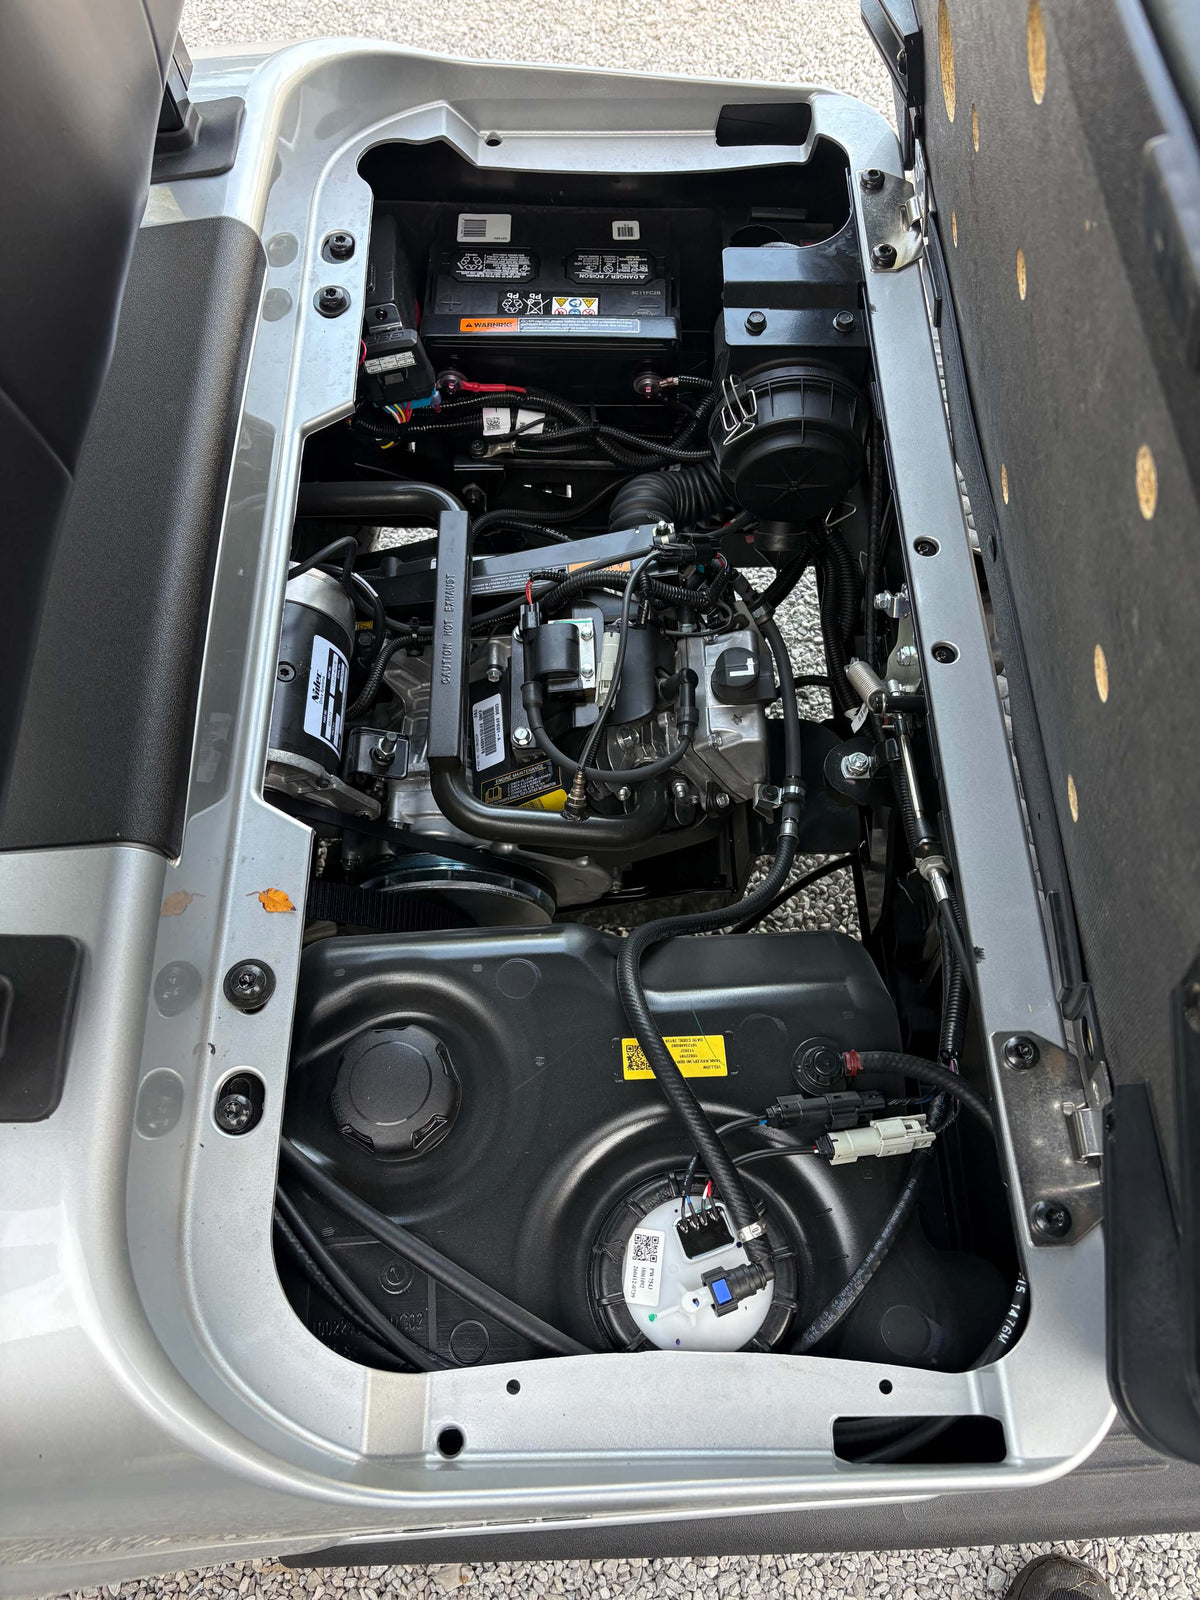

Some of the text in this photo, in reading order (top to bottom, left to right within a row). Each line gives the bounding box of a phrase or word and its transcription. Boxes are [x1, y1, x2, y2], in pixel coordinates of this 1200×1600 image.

[440, 573, 456, 685] CAUTION HOT EXHAUST
[312, 669, 322, 701] Nidec
[512, 763, 544, 778] MAINTENANCE
[997, 1303, 1021, 1344] 1476M
